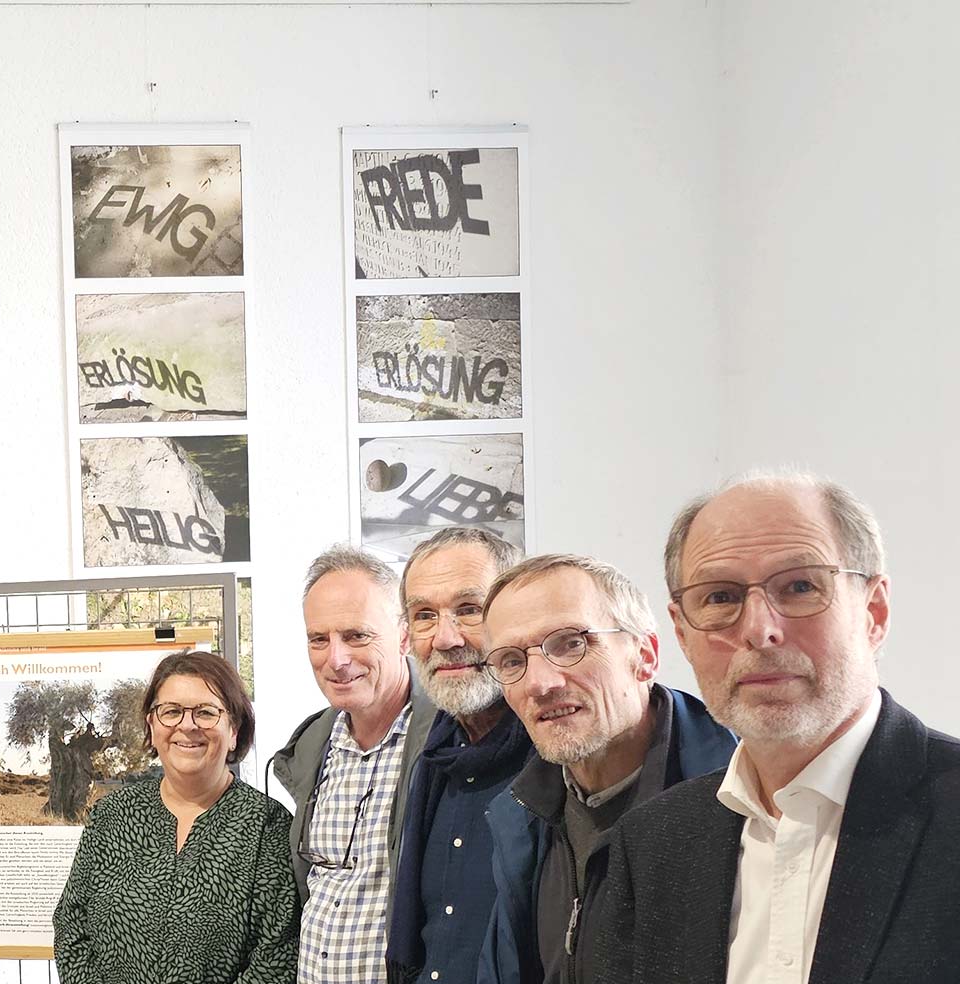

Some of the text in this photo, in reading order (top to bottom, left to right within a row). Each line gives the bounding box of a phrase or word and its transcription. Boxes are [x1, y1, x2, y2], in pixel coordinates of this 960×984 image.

[361, 149, 490, 236] FRIEDE
[90, 184, 217, 265] EWIG
[79, 347, 208, 405] ERLÖSUNG
[372, 342, 510, 405] ERLÖSUNG
[98, 503, 223, 555] HEILIG
[11, 661, 103, 675] Willkommen!
